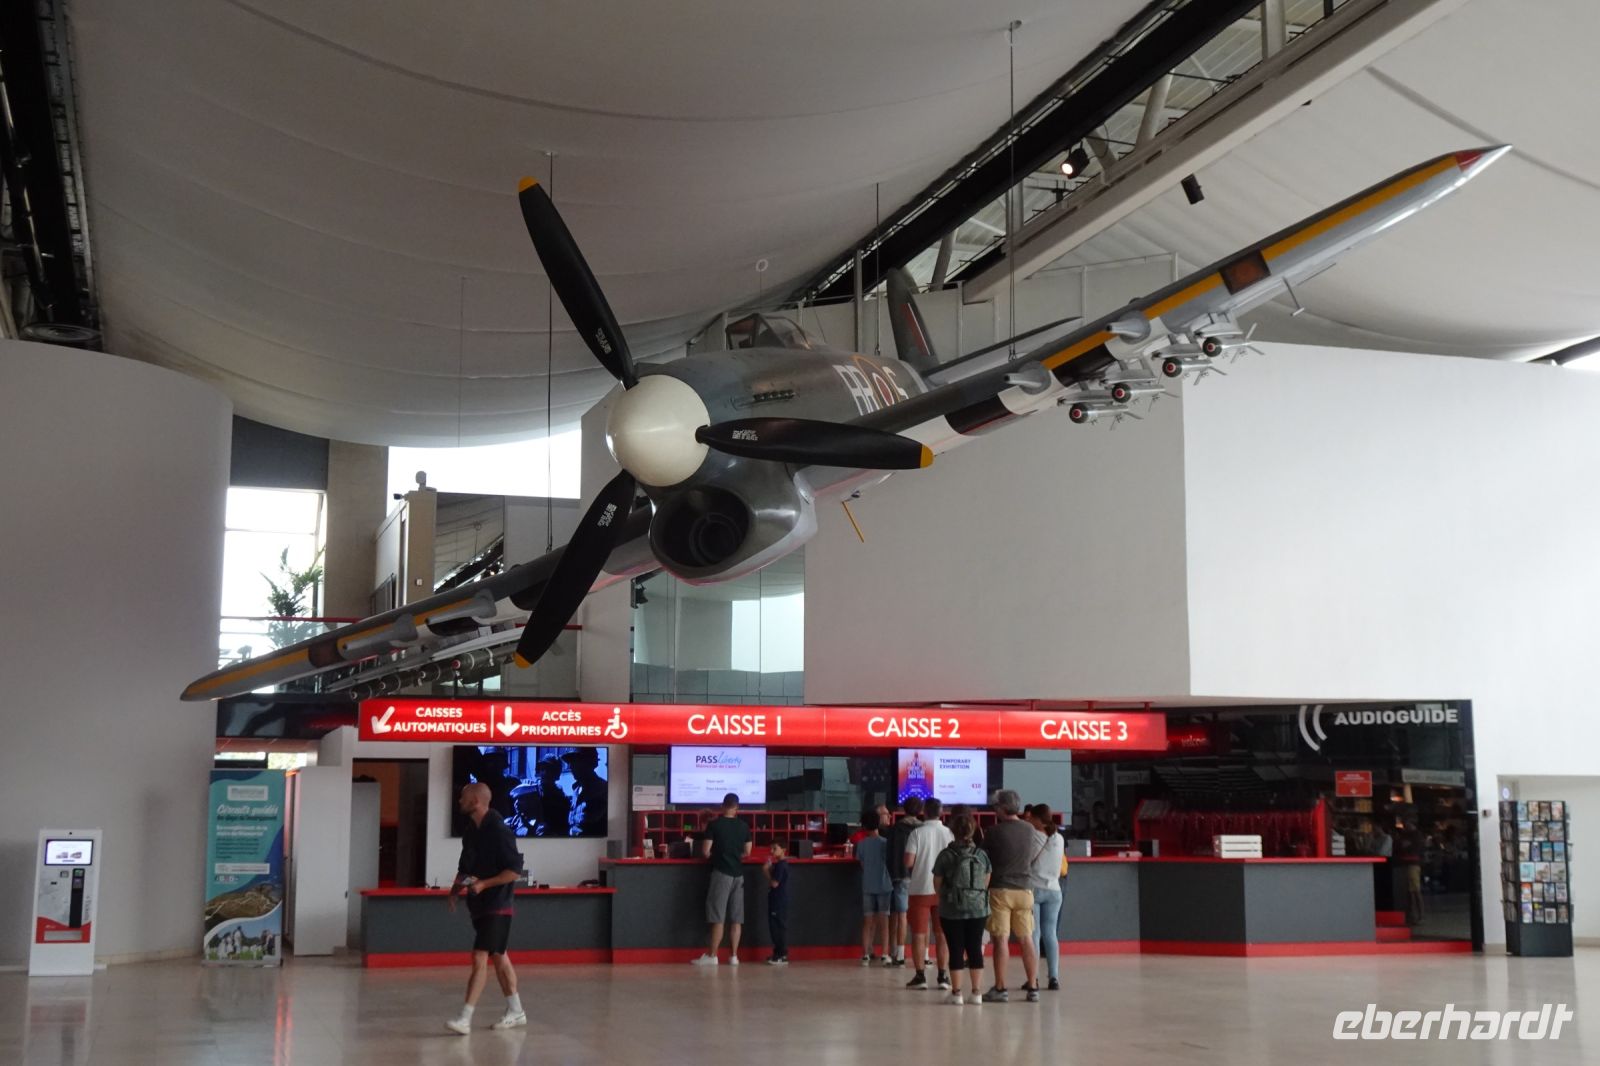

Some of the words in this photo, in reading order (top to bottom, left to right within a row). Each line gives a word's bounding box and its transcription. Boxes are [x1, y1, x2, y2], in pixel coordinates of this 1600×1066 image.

[415, 707, 463, 718] CAISSES
[541, 709, 582, 722] ACCÈS
[1334, 709, 1459, 726] AUDIOGUIDE
[393, 721, 487, 734] AUTOMATIQUES
[521, 725, 601, 737] PRIORITAIRES
[687, 714, 766, 736] CAISSE
[867, 717, 942, 738] CAISSE
[948, 718, 961, 738] 2
[1040, 720, 1111, 741] CAISSE
[1117, 722, 1128, 741] 3
[695, 755, 718, 764] PASS
